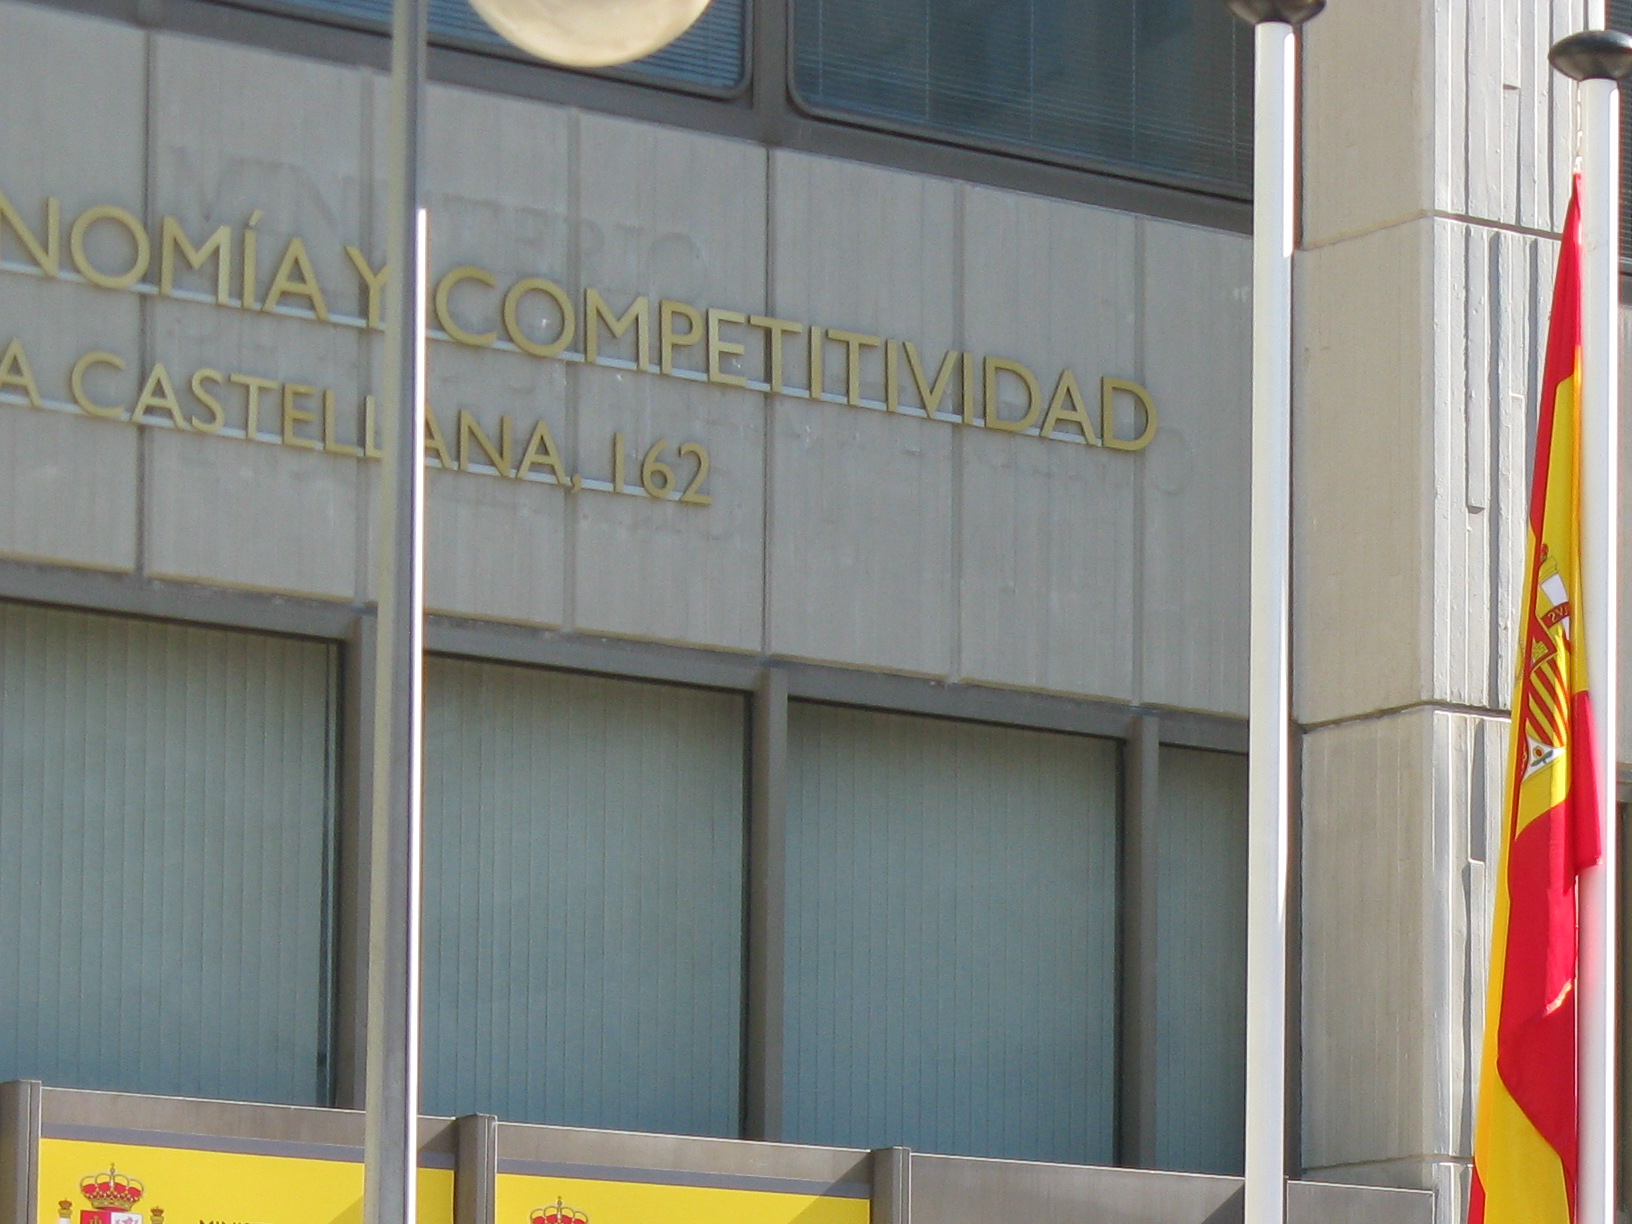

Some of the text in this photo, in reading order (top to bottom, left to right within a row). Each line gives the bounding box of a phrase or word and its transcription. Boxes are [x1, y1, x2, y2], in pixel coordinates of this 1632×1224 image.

[0, 338, 42, 408] A
[612, 431, 712, 504] 162
[344, 245, 389, 329] Y
[434, 264, 1158, 452] COMPETITIVIDAD
